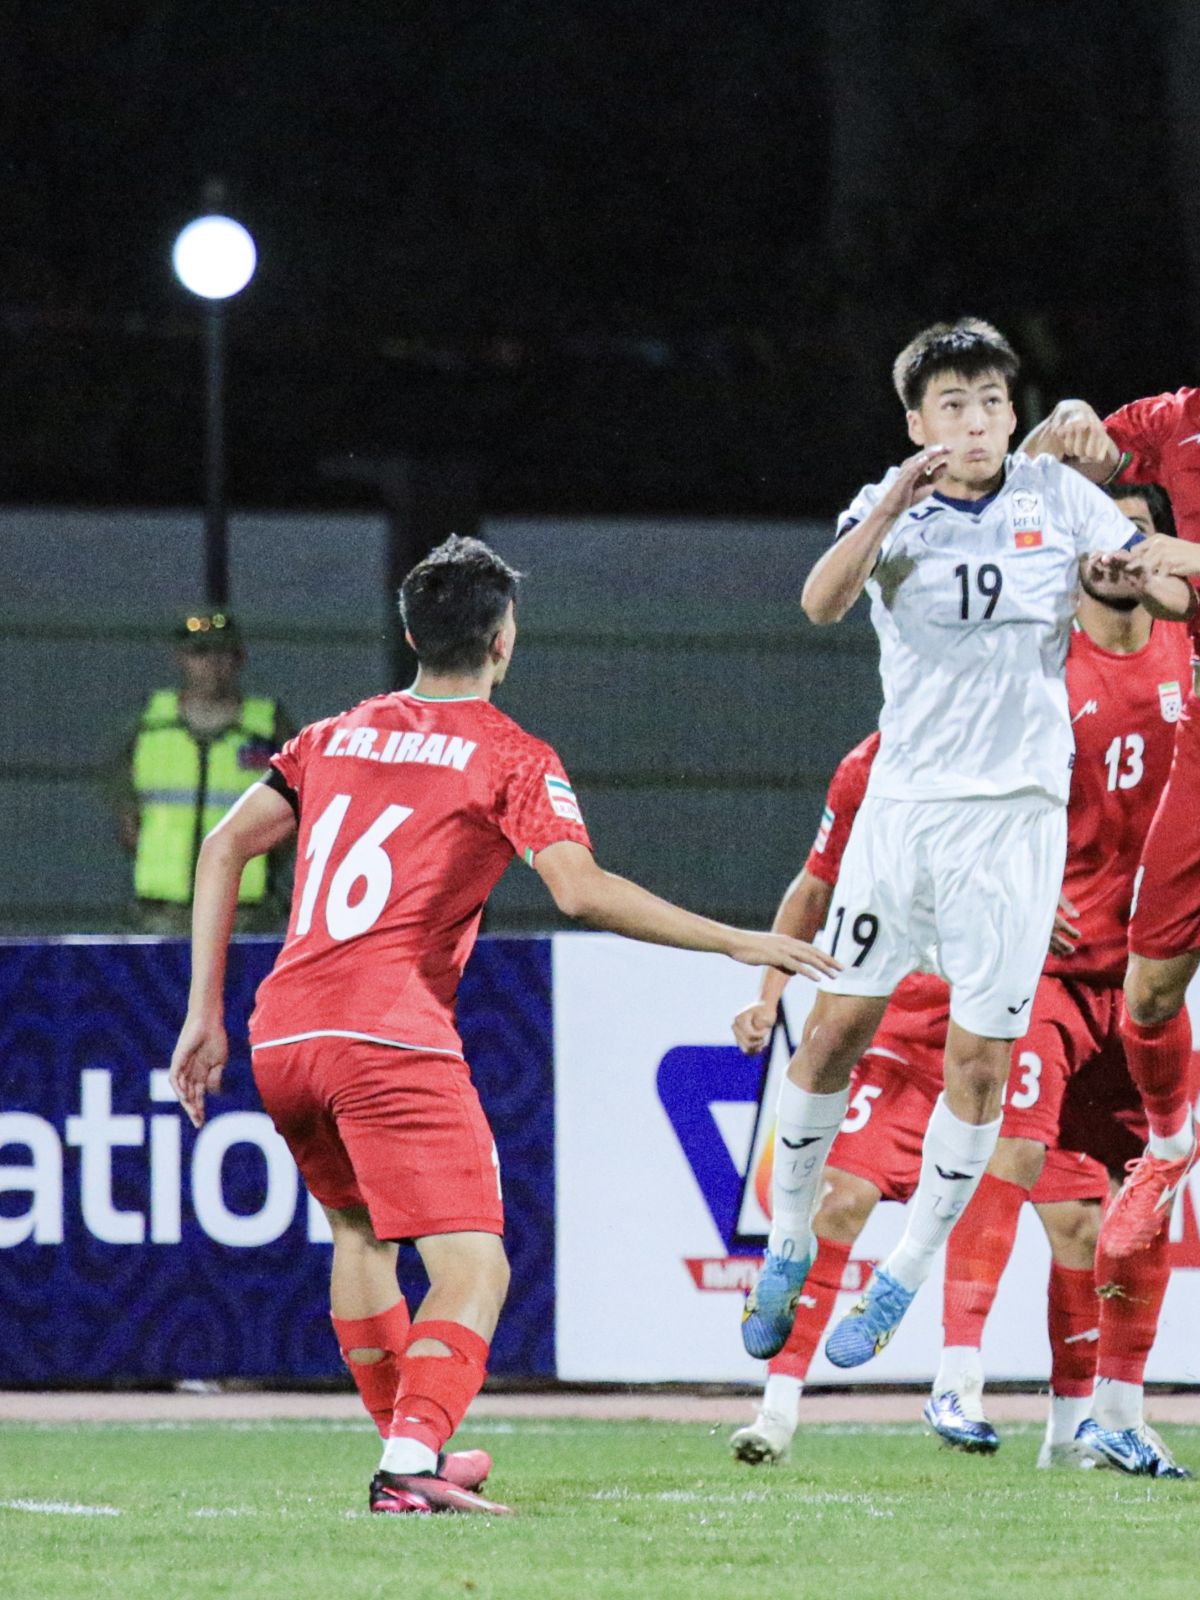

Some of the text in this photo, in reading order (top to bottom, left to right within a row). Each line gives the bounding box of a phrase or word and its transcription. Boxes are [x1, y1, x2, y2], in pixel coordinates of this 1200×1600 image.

[953, 563, 1002, 621] 19
[322, 726, 479, 772] I.R.IRAN
[1104, 733, 1146, 792] 13
[295, 793, 415, 942] 16
[830, 907, 879, 967] 19
[1001, 1050, 1042, 1109] 3
[0, 1068, 334, 1248] atio
